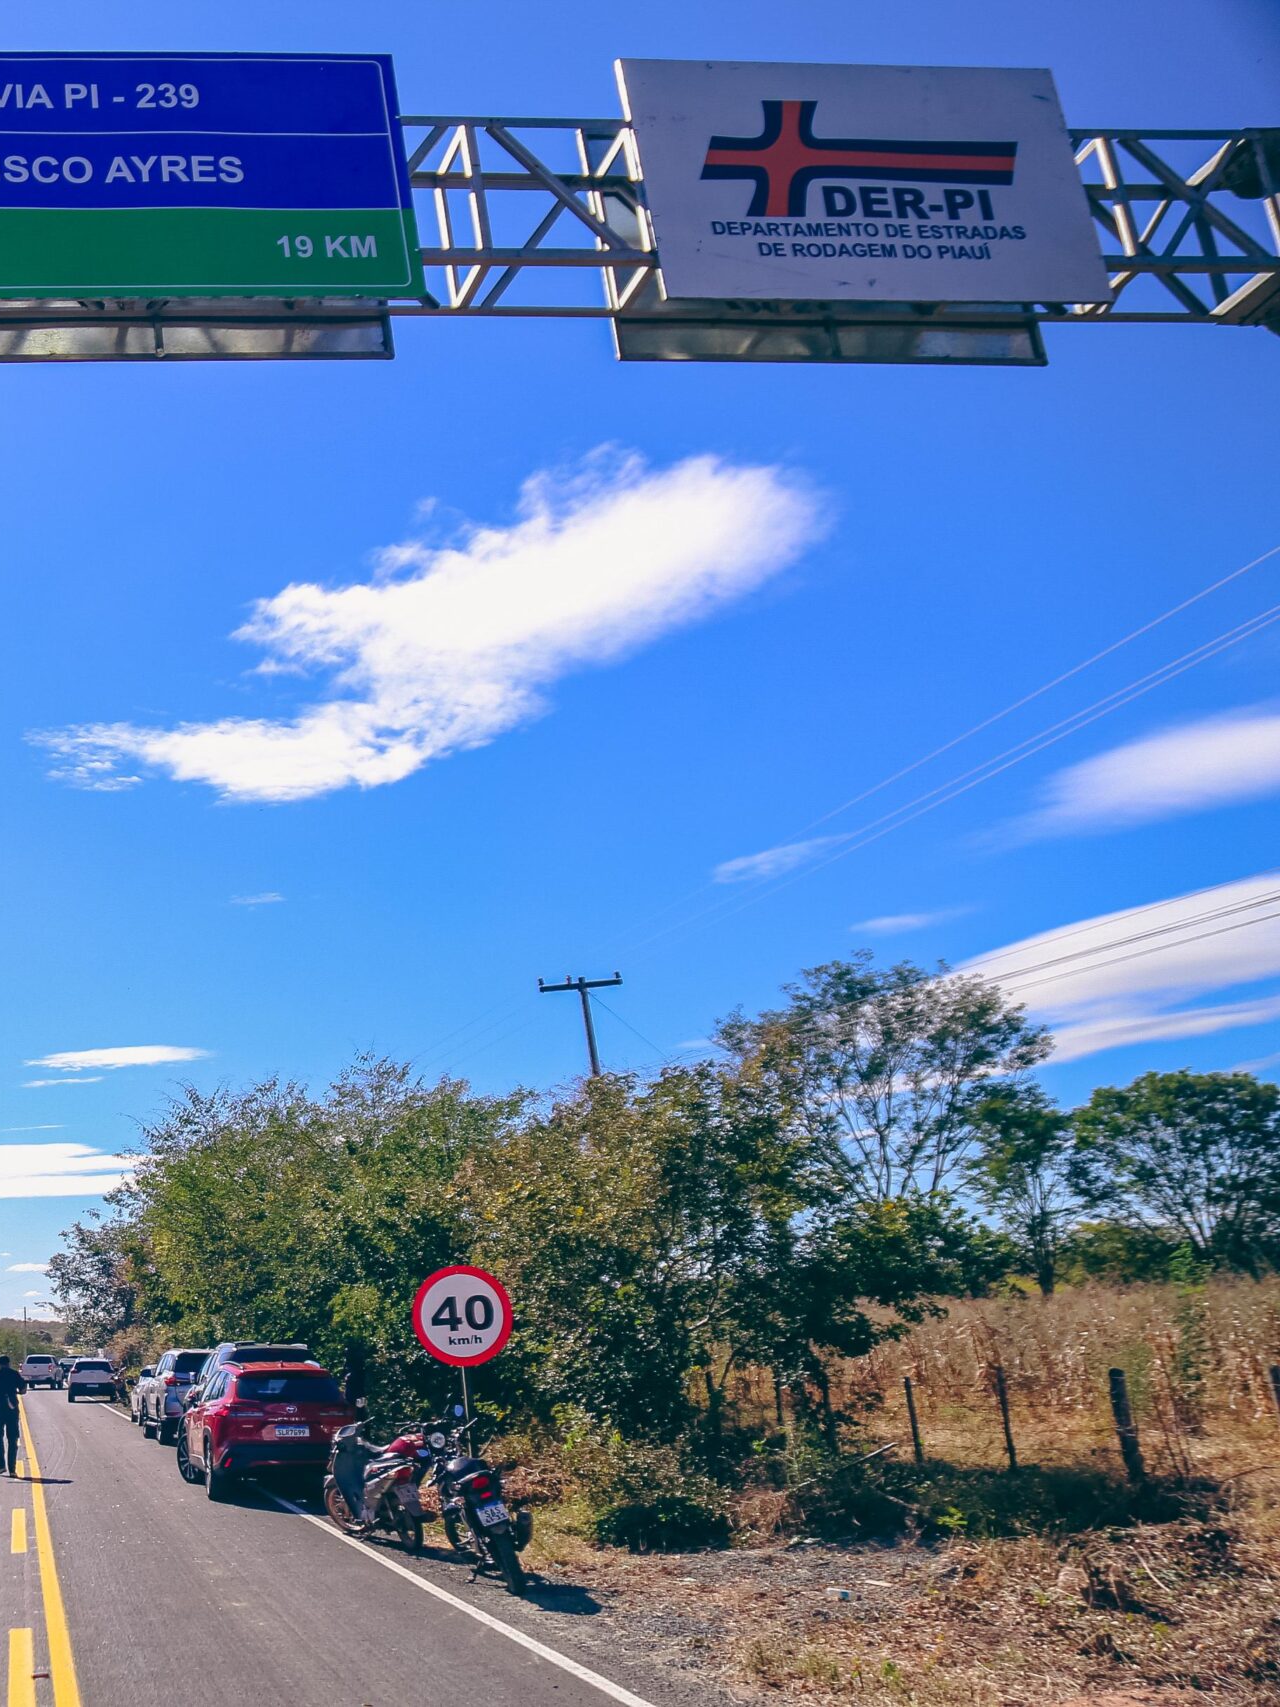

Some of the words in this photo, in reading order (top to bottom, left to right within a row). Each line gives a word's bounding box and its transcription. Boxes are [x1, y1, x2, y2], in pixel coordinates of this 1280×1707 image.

[64, 83, 99, 109] PI
[135, 83, 200, 109] 239
[104, 155, 245, 184] AYRES
[822, 186, 995, 221] DER-PI
[711, 221, 879, 237] DEPARTAMENTO
[884, 223, 912, 238] DE
[917, 224, 1027, 240] ESTRADAS
[276, 235, 314, 258] 19
[324, 235, 378, 258] KM
[758, 242, 787, 257] DE
[792, 243, 897, 258] RODAGEM
[902, 244, 932, 259] DO
[937, 242, 992, 260] PIAUÍ
[431, 1294, 495, 1332] 40
[448, 1335, 483, 1345] km/h
